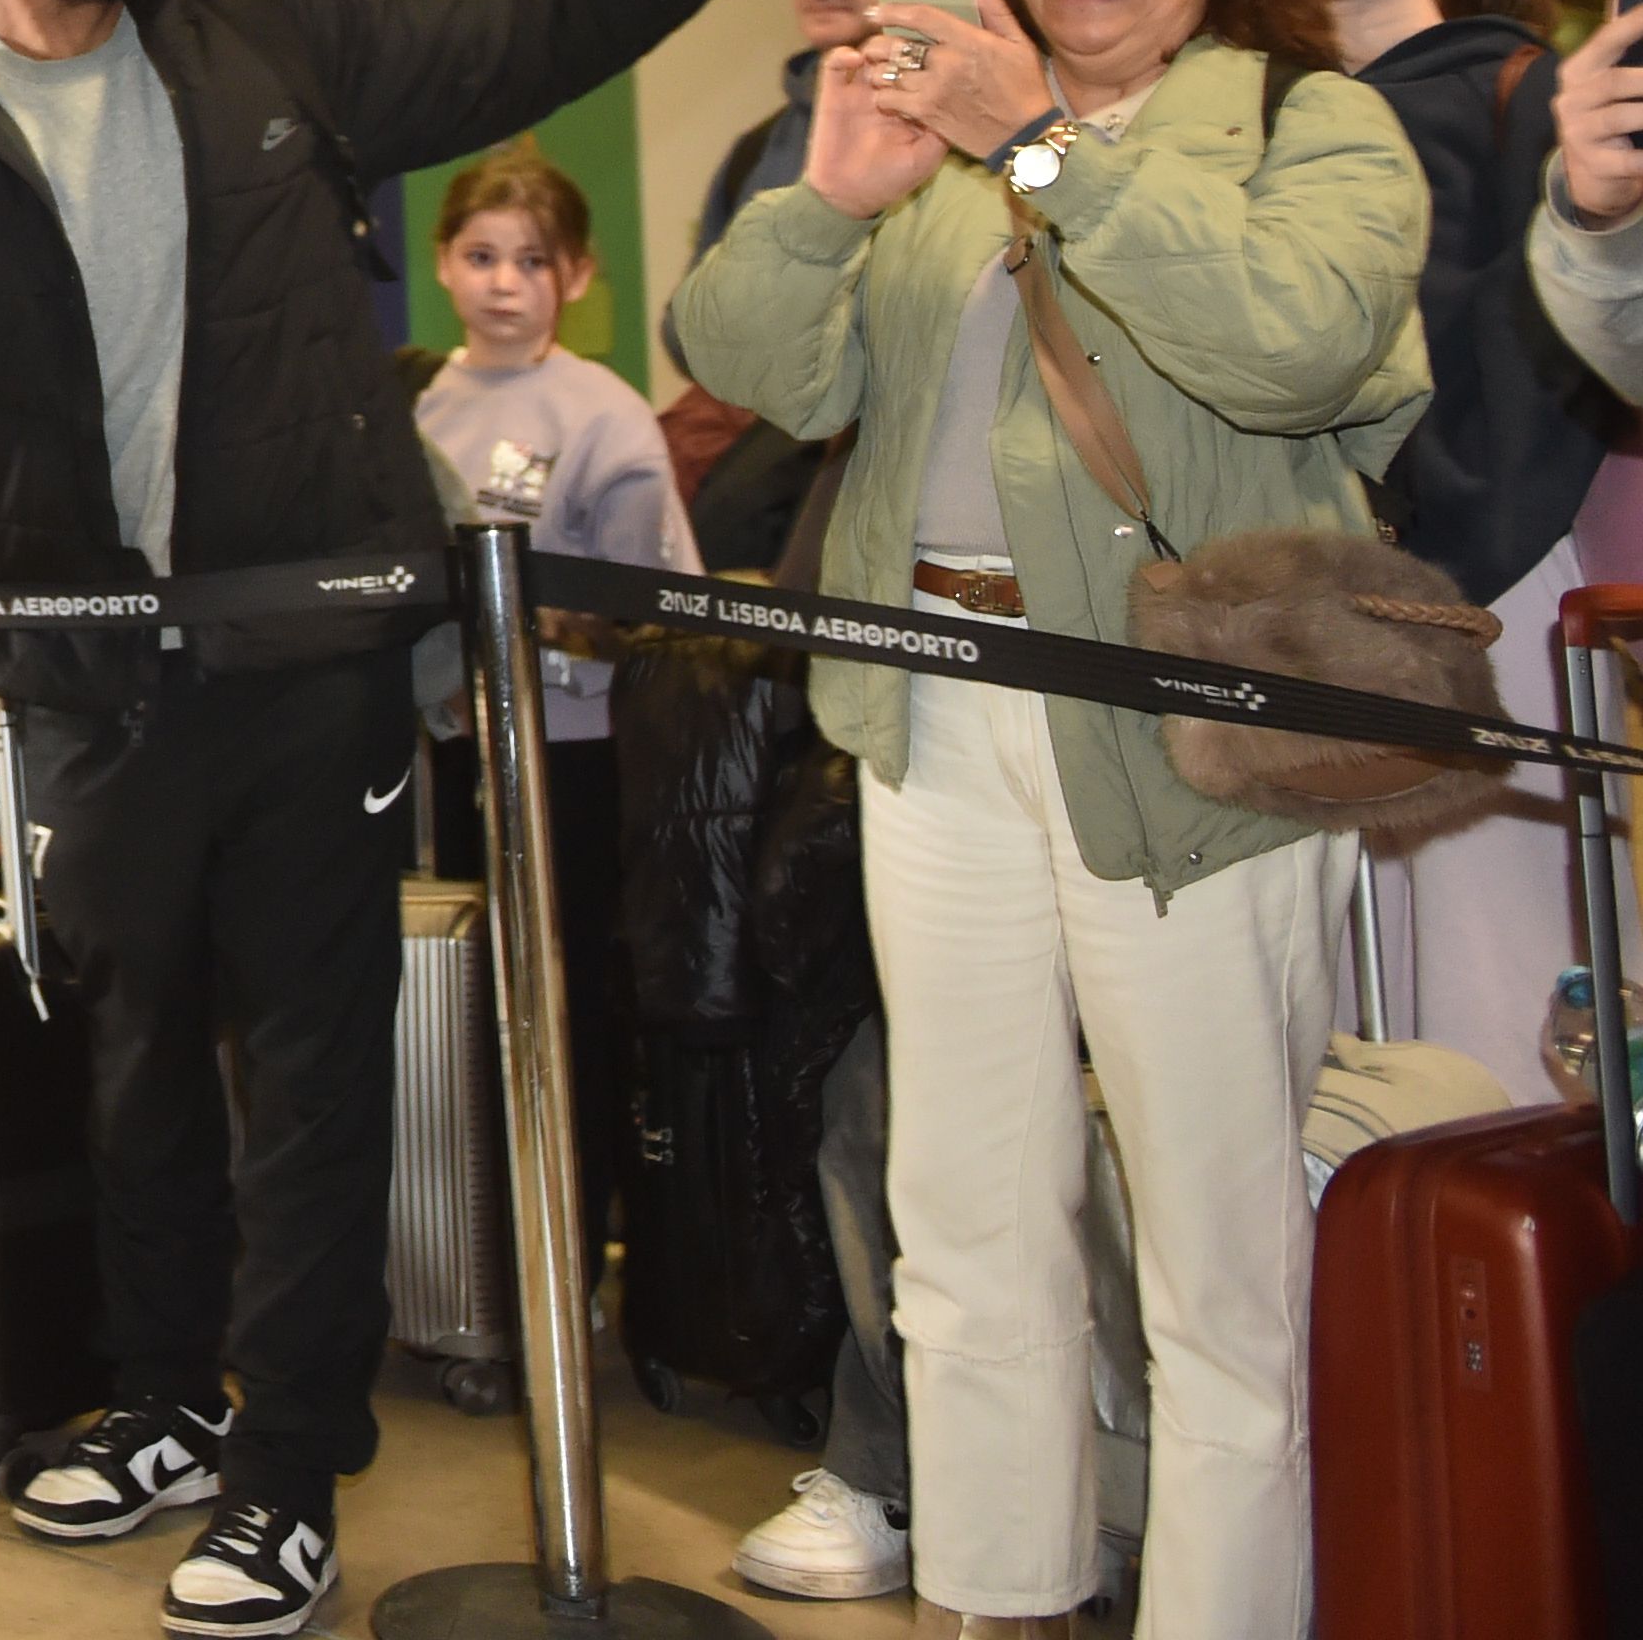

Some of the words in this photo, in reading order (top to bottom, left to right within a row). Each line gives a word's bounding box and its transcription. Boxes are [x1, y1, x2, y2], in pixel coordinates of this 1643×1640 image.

[10, 594, 160, 617] AEROPORTO
[811, 617, 980, 664] AEROPORTO
[1153, 676, 1230, 699] VINCI
